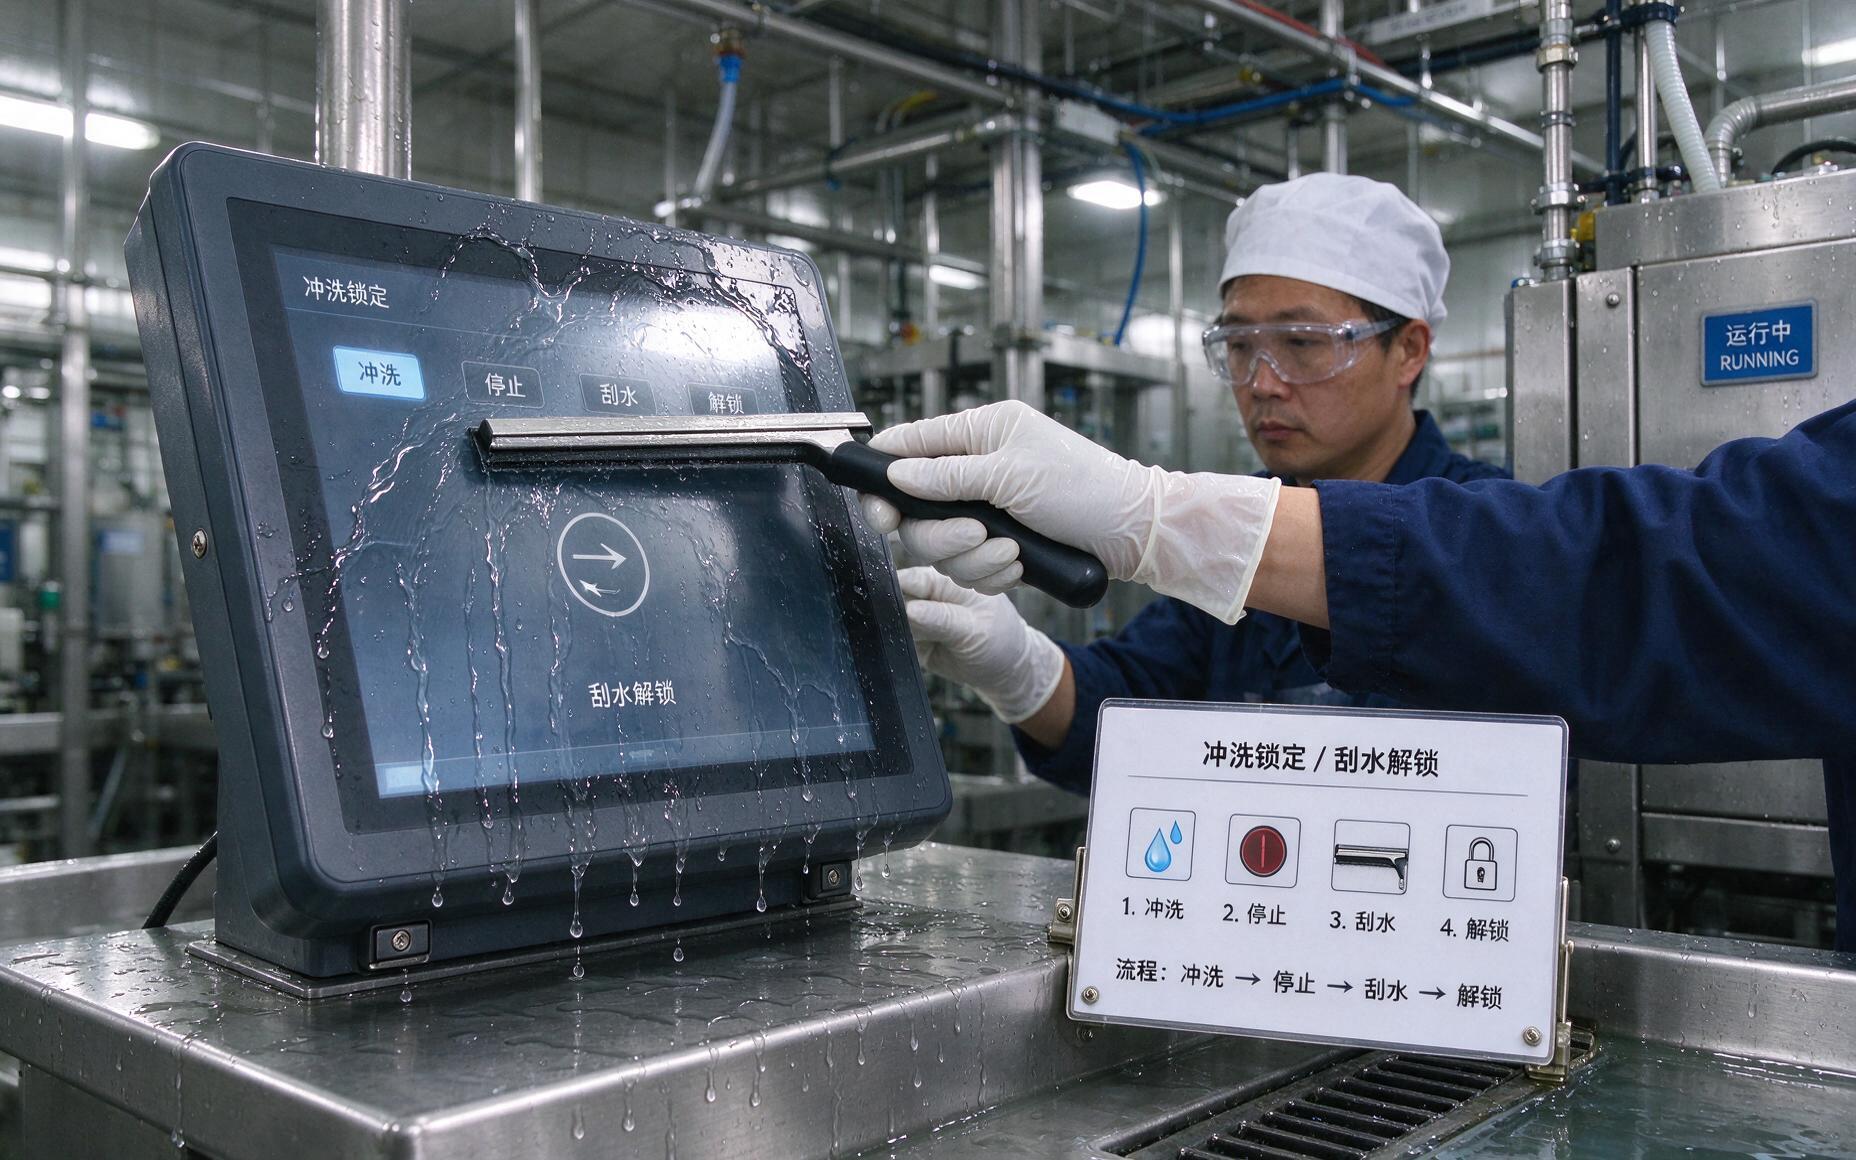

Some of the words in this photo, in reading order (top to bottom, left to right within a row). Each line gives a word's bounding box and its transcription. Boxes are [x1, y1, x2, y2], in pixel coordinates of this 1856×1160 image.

[304, 276, 390, 308] 冲洗锁定
[1726, 319, 1791, 347] 运行中
[1720, 349, 1799, 371] RUNNING
[358, 361, 402, 386] 冲洗
[485, 372, 526, 398] 停止
[600, 383, 639, 407] 刮水
[708, 391, 745, 415] 解锁
[588, 679, 677, 708] 刮水解锁
[1202, 740, 1306, 772] 冲洗锁定
[1334, 745, 1439, 778] 刮水解锁
[1122, 896, 1135, 916] 1.
[1144, 897, 1184, 920] 冲洗
[1222, 903, 1239, 923] 2.
[1247, 902, 1287, 926] 停止
[1329, 910, 1346, 930] 3.
[1355, 911, 1396, 934] 刮水
[1439, 918, 1457, 938] 4.
[1465, 917, 1509, 943] 解锁
[1115, 957, 1167, 982] 流程：
[1180, 963, 1224, 988] 冲洗
[1272, 969, 1316, 994] 停止
[1364, 977, 1408, 1002] 刮水
[1456, 983, 1502, 1010] 解锁
